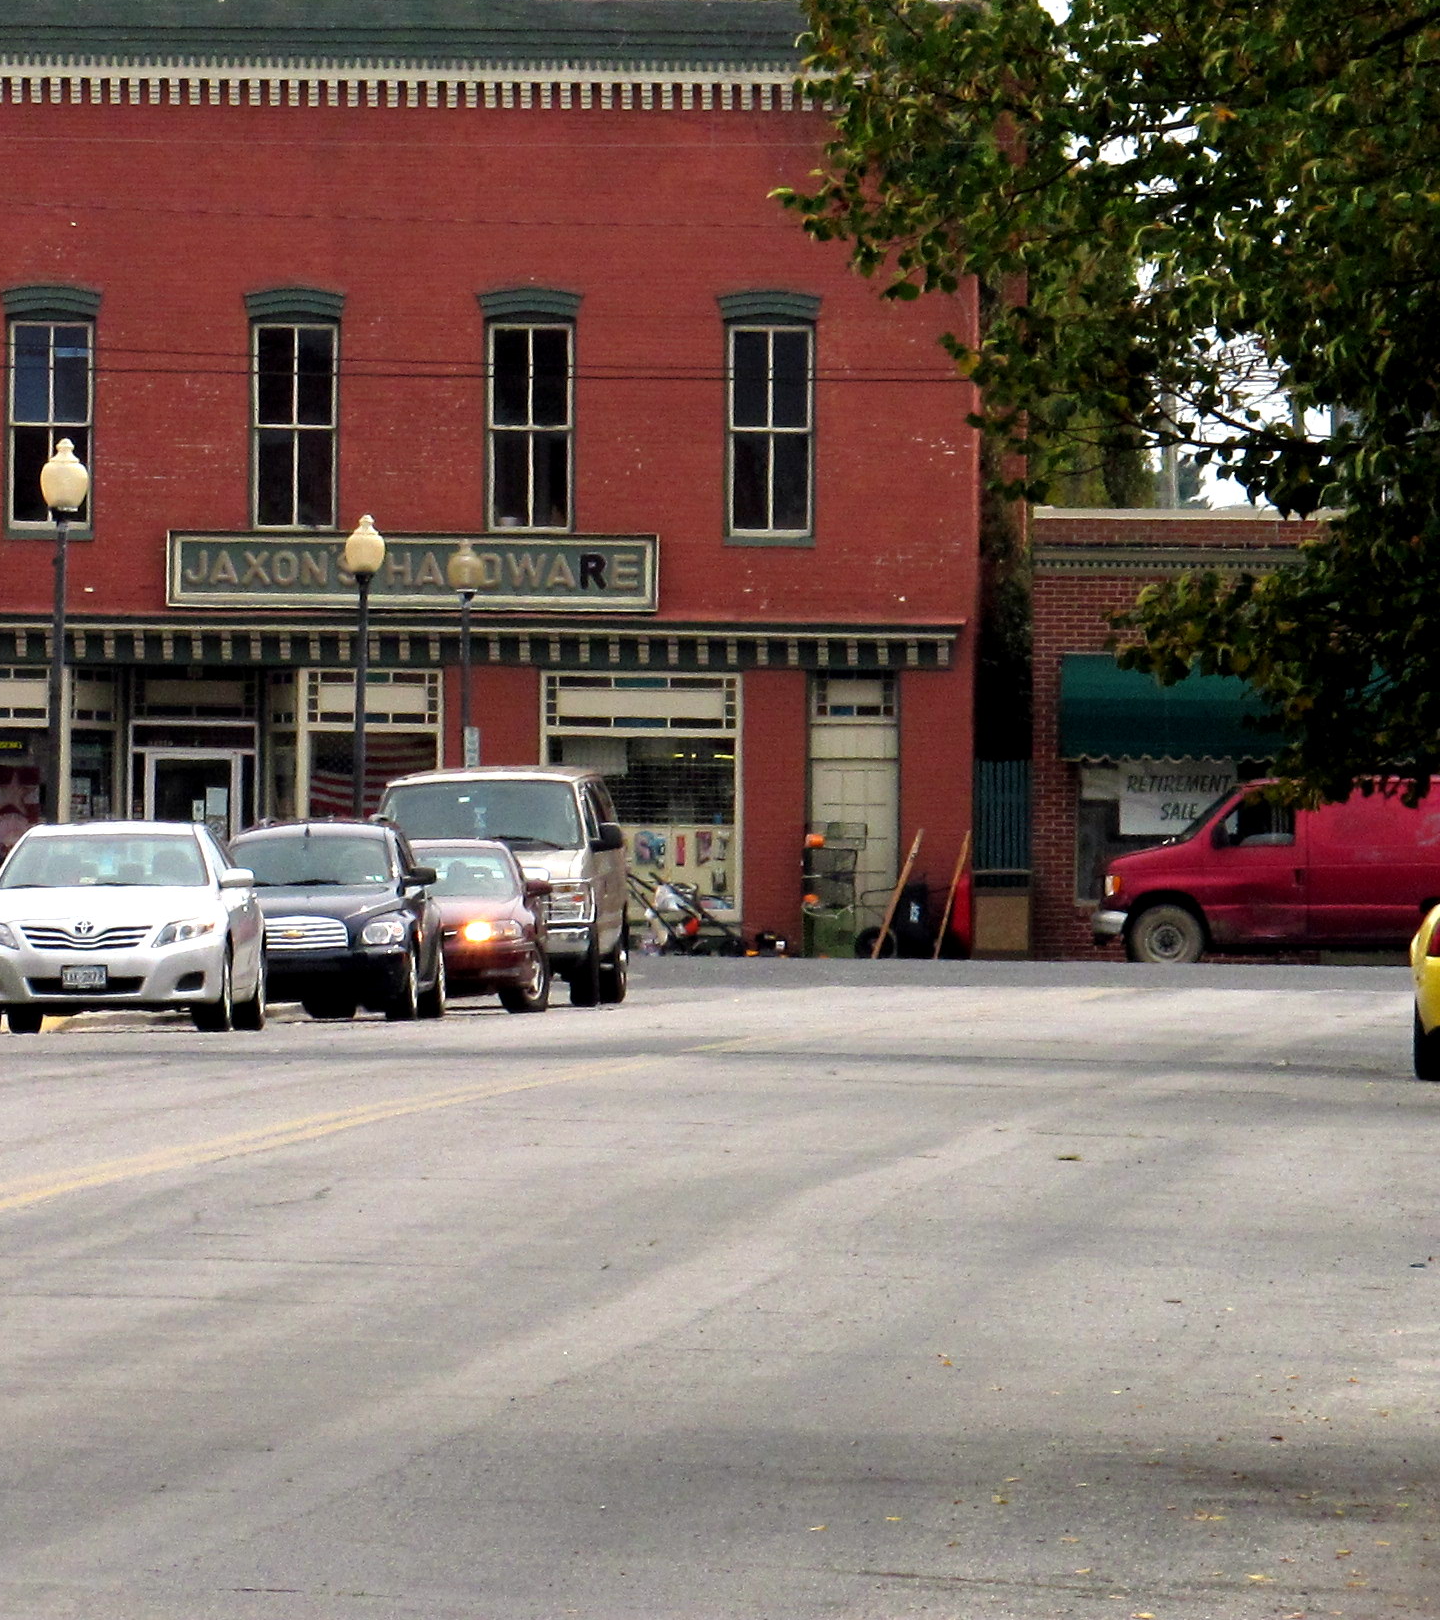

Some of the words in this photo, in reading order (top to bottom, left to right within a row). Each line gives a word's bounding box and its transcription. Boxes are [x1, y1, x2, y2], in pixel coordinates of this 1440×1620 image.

[386, 550, 639, 592] HADWARE
[1126, 773, 1232, 793] RETIREMENT
[1160, 802, 1199, 820] SALE
